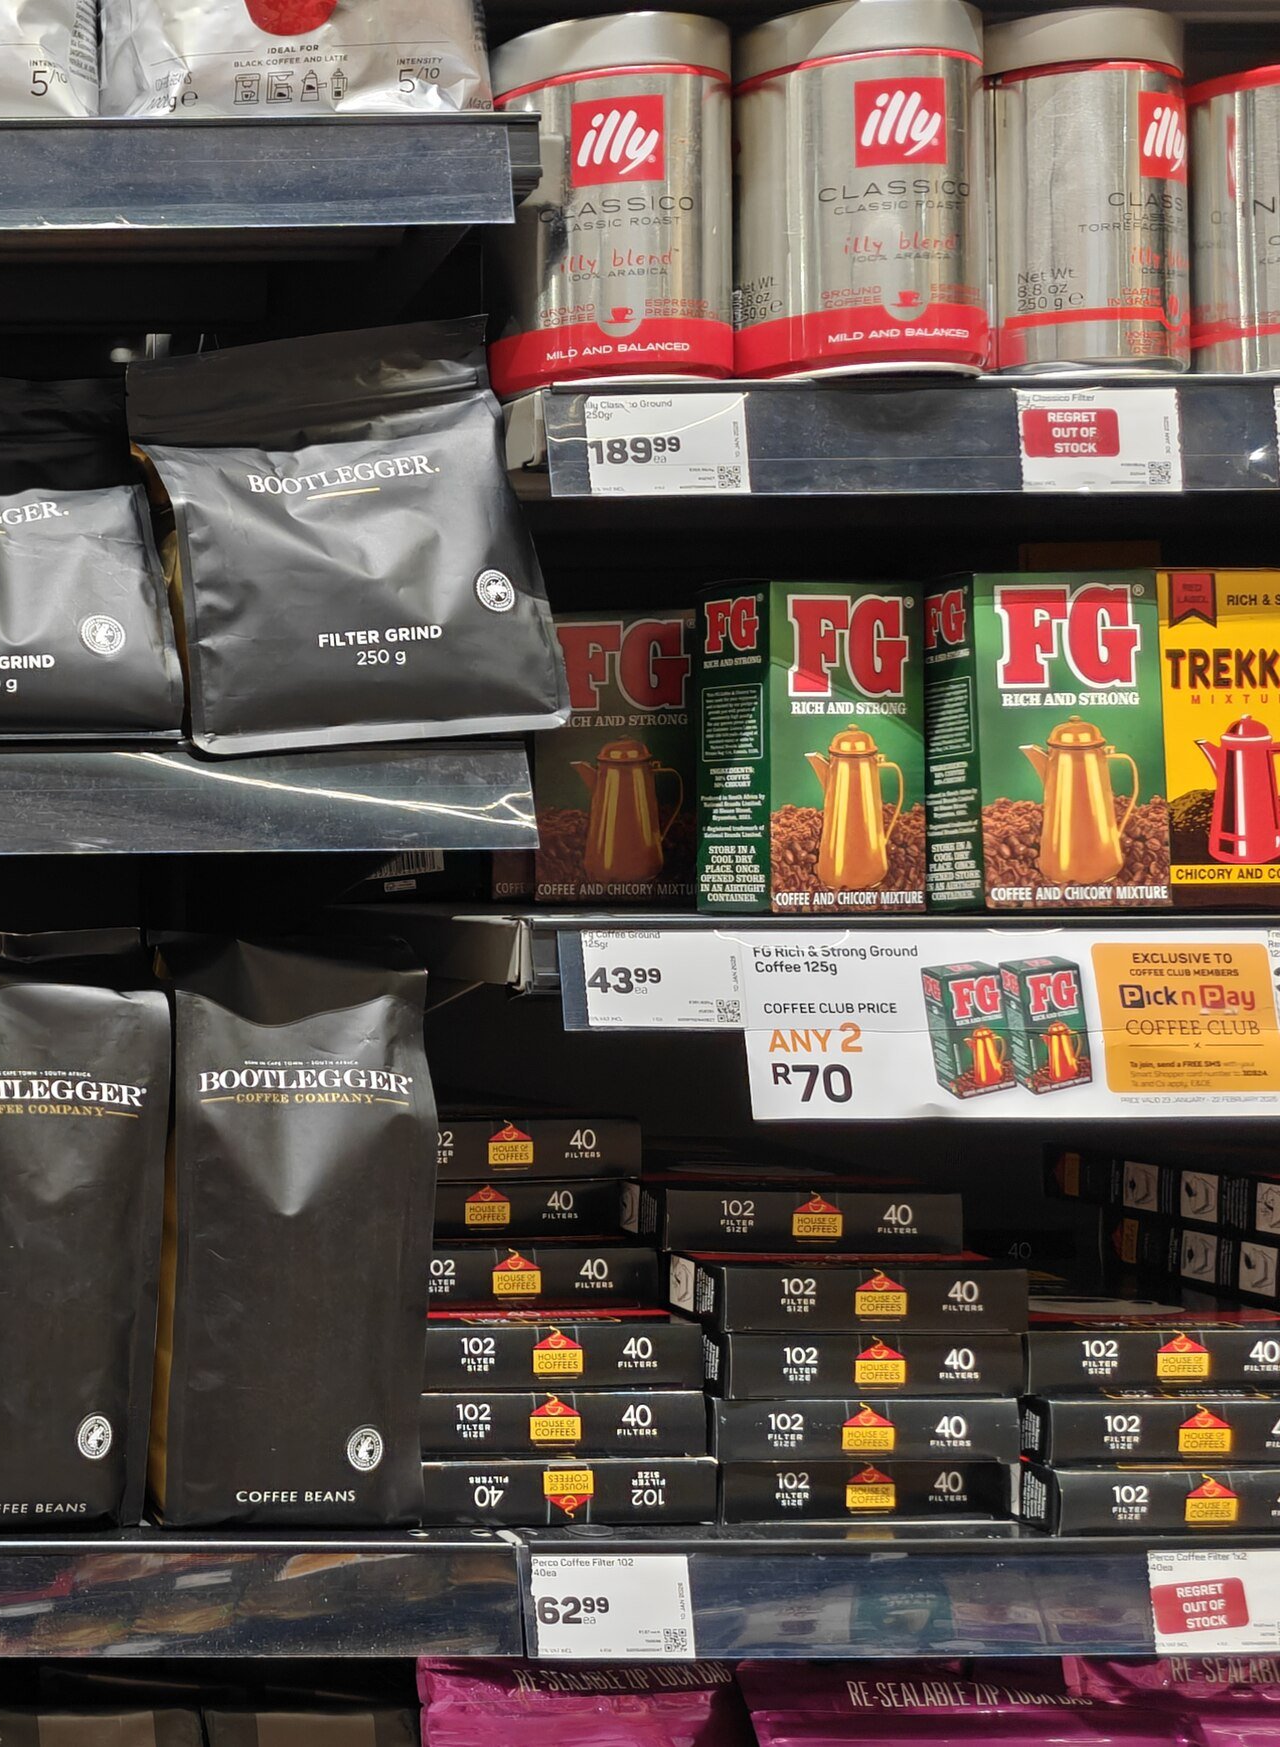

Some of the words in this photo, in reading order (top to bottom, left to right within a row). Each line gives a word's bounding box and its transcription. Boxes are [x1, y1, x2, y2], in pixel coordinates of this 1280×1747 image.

[860, 90, 941, 157] illy
[577, 109, 659, 175] illy
[818, 179, 970, 202] CLASSICO
[546, 348, 578, 361] MILD
[582, 345, 613, 356] AND
[617, 342, 690, 353] BALANCED
[1047, 412, 1097, 423] REGRET
[1052, 427, 1078, 438] OUT
[1080, 427, 1097, 437] OF
[1054, 443, 1097, 453] STOCK
[318, 630, 382, 648] FILTER
[385, 626, 442, 644] GRIND
[787, 594, 909, 698] FG
[356, 651, 389, 666] 250
[395, 653, 407, 669] g
[791, 701, 825, 715] RICH
[826, 701, 854, 714] AND
[856, 702, 906, 715] STRONG
[711, 854, 733, 864] COOL
[735, 854, 753, 864] DRY
[776, 893, 810, 906] COFFEE
[812, 892, 835, 905] AND
[837, 891, 878, 905] CHICORY
[880, 890, 923, 904] MIXTURE
[753, 945, 769, 957] FG
[774, 944, 800, 957] Rich
[803, 946, 816, 957] &
[820, 944, 864, 961] Strong
[868, 944, 918, 958] Ground
[1132, 953, 1211, 964] EXCLUSIVE
[1215, 953, 1233, 964] TO
[755, 960, 799, 974] Coffee
[803, 961, 837, 977] 125g
[1193, 969, 1239, 977] MEMBERS
[1181, 991, 1196, 1006] n
[1199, 985, 1255, 1011] Pay
[763, 1002, 812, 1015] COFFEE
[817, 1002, 852, 1015] CLUB
[857, 1001, 897, 1014] PRICE
[1125, 1019, 1202, 1036] COFFEE
[1207, 1020, 1260, 1036] CLUB
[769, 1027, 836, 1053] ANY
[841, 1021, 863, 1053] 2
[29, 1103, 106, 1116] COMPANY
[781, 1278, 816, 1296] 102
[947, 1280, 979, 1303] 40
[860, 1294, 892, 1303] HOUSE
[860, 1303, 902, 1312] COFFEES
[942, 1304, 983, 1312] FILTERS
[461, 1337, 495, 1355] 102
[622, 1337, 652, 1359] 40
[461, 1357, 495, 1365] FILTER
[467, 1364, 489, 1372] SIZE
[532, 1556, 557, 1569] Perco
[560, 1557, 587, 1568] Coffee
[591, 1557, 614, 1567] Filter
[617, 1557, 634, 1567] 102
[847, 1680, 970, 1709] RE-SEALABLE
[975, 1683, 1005, 1709] ZIP
